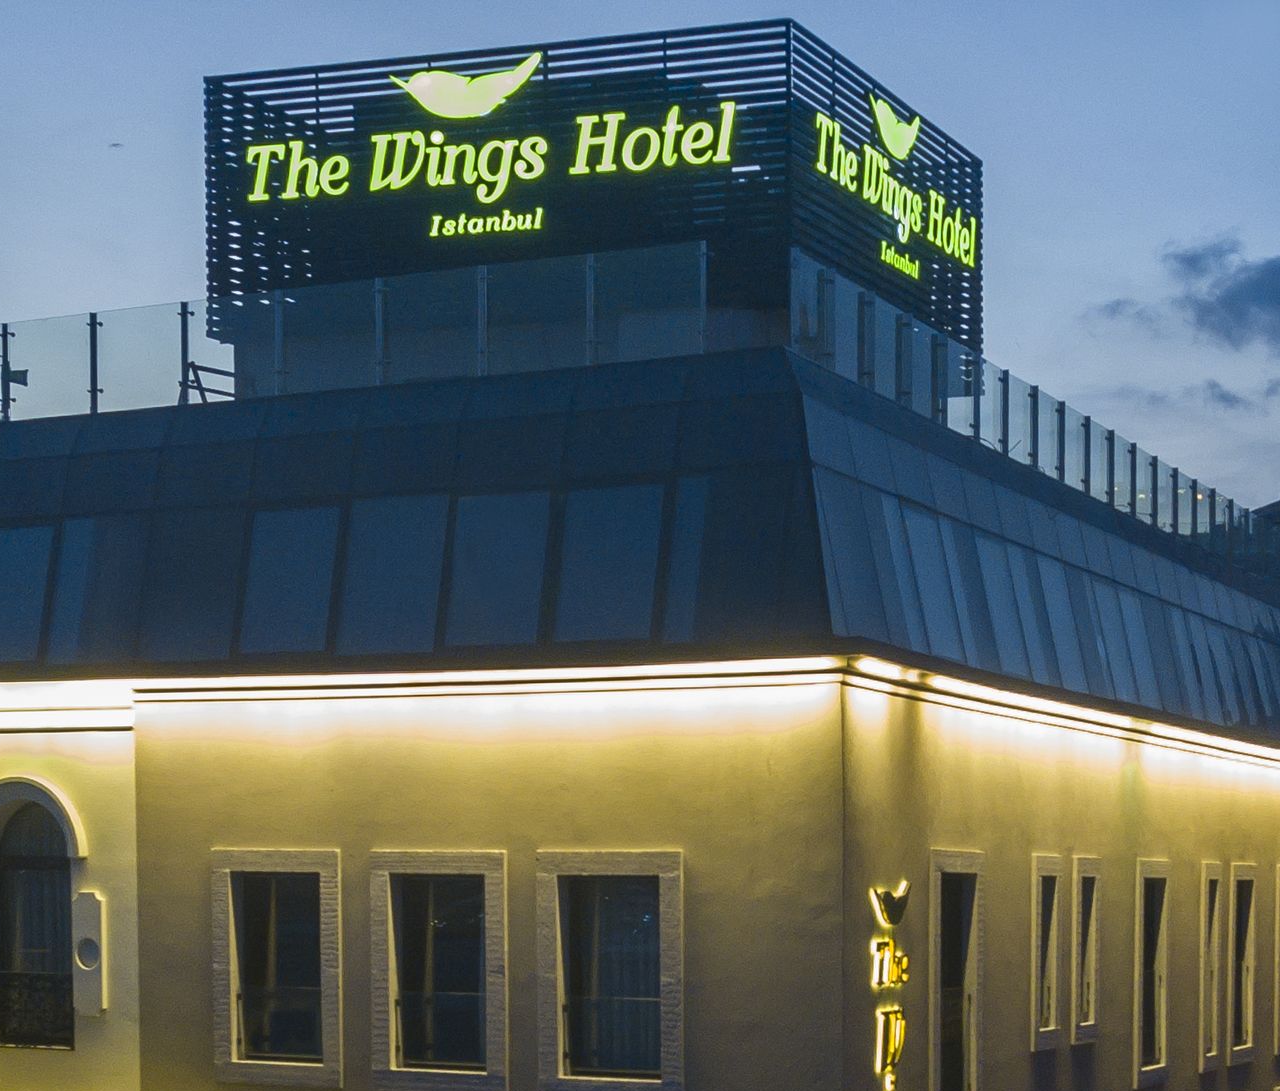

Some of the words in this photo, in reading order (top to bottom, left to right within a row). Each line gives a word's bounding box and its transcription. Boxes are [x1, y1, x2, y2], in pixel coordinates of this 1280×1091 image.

[246, 141, 350, 201] The
[369, 130, 548, 204] Wings
[568, 101, 737, 176] Hotel
[816, 112, 858, 192] The
[863, 144, 923, 244] Wings
[927, 189, 976, 268] Hotel
[429, 207, 543, 238] Istanbul
[881, 240, 919, 280] Istanbul
[870, 938, 910, 986] The
